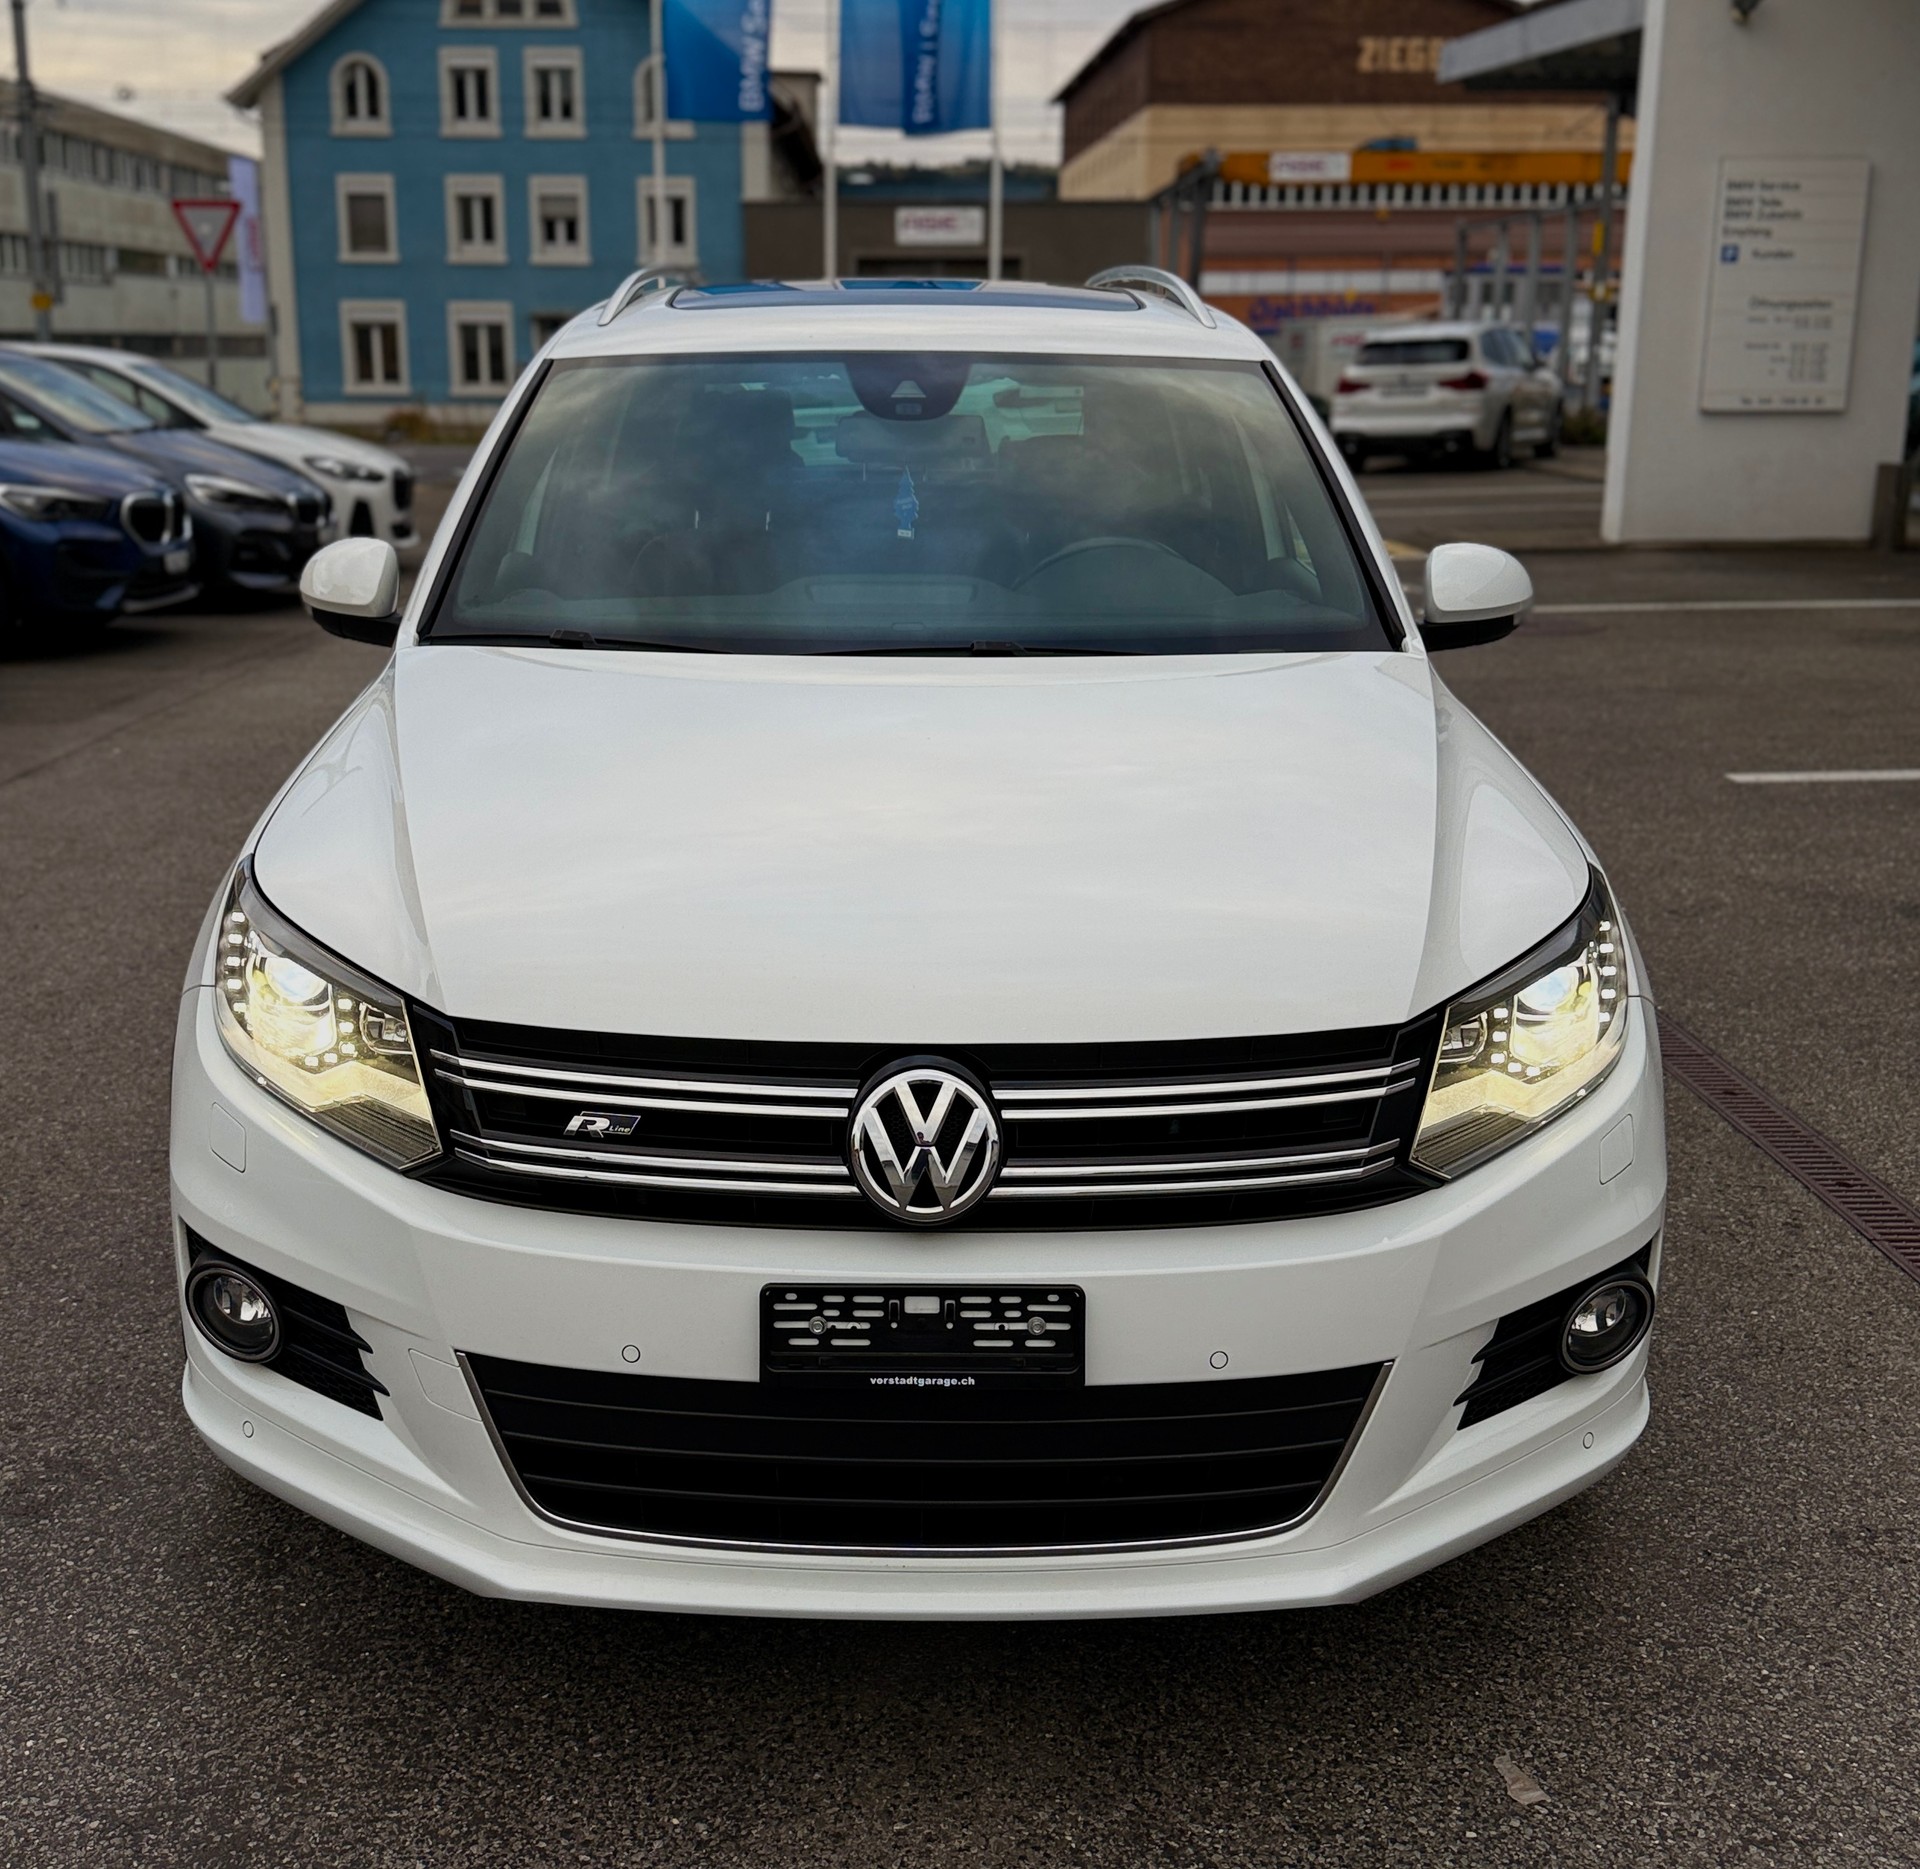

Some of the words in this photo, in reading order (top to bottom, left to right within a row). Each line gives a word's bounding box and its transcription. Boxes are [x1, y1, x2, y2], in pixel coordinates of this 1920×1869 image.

[738, 36, 765, 112] BMW
[563, 1115, 611, 1138] R
[870, 1376, 976, 1387] vorstadtgarage.ch
